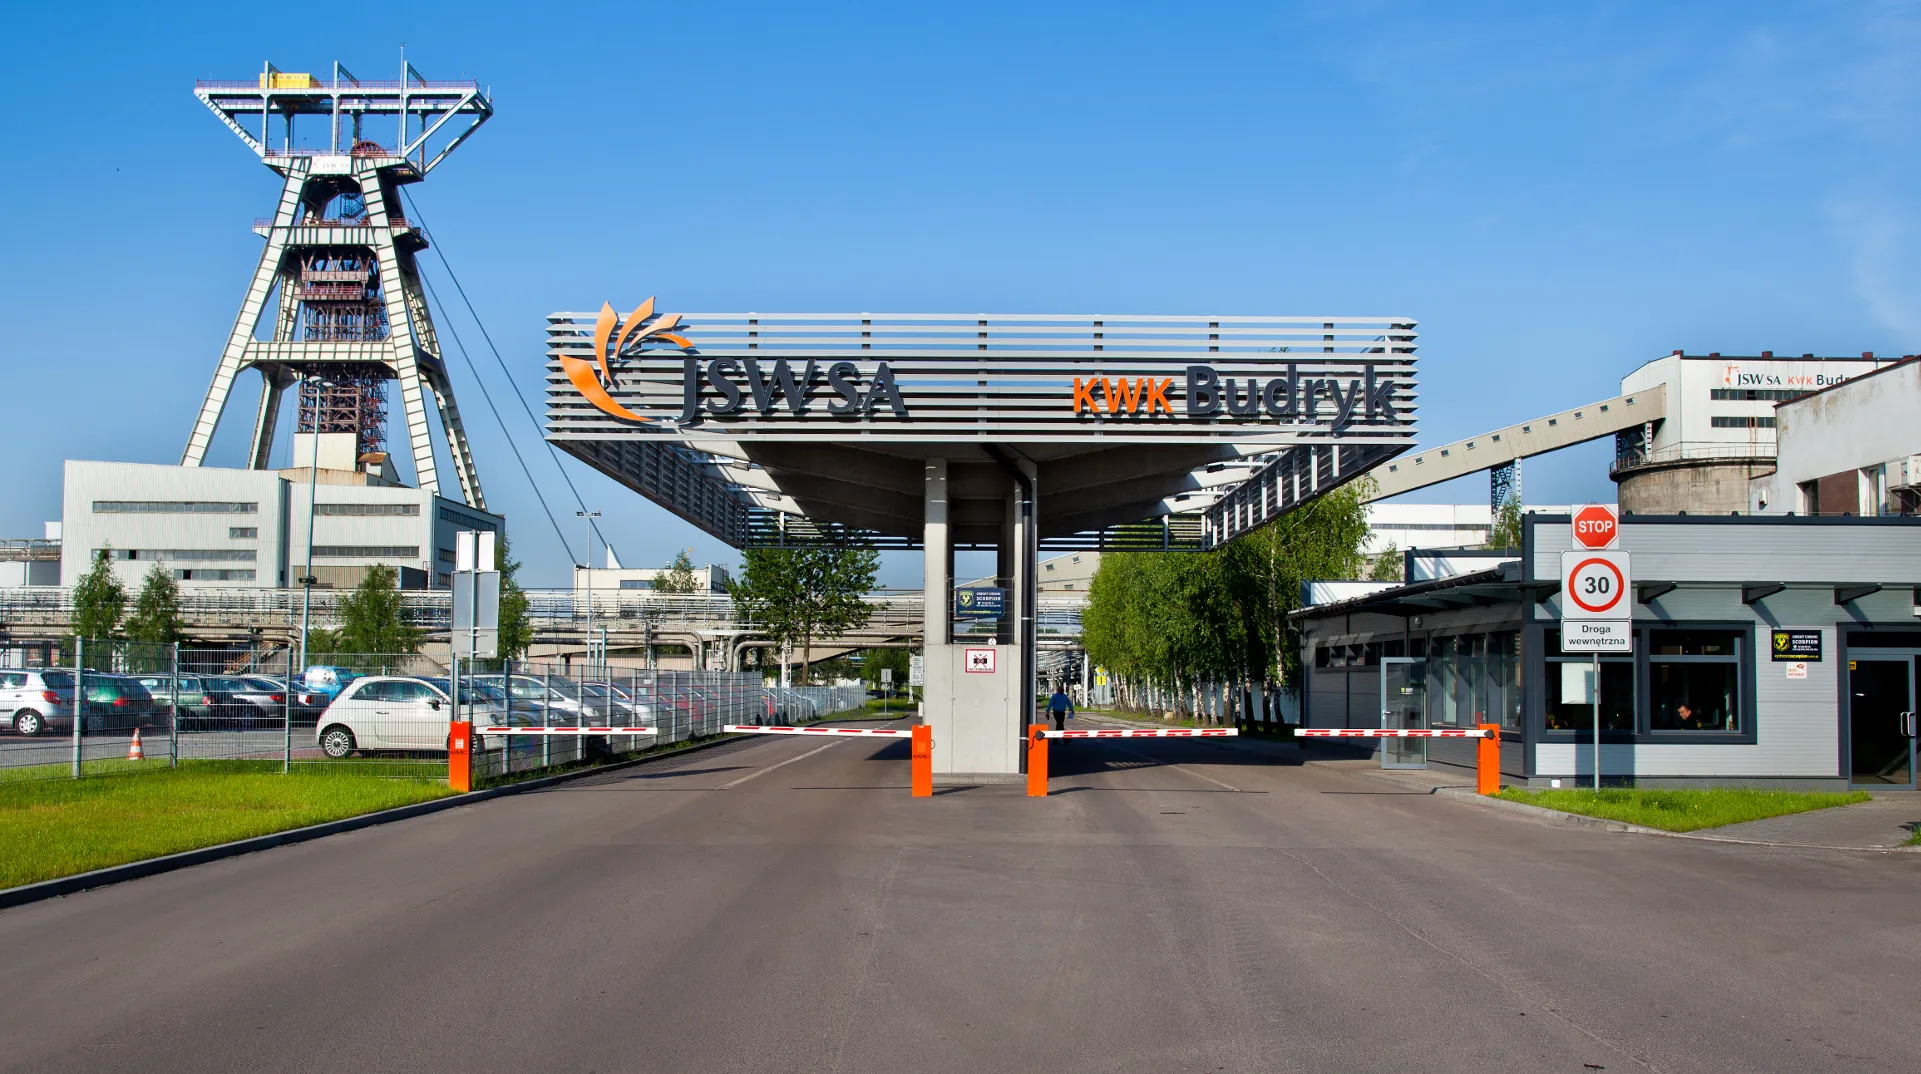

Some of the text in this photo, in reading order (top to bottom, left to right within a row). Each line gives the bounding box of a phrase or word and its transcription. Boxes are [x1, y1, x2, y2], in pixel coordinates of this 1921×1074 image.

[1737, 373, 1764, 386] JSW
[1766, 375, 1781, 385] SA
[1788, 376, 1813, 385] KWK
[677, 357, 907, 425] JSW SA
[1073, 364, 1397, 429] KWK Budryk
[1578, 520, 1613, 533] STOP
[1584, 576, 1610, 594] 30
[1582, 625, 1611, 635] Droga
[1568, 637, 1626, 647] wewnętrzna
